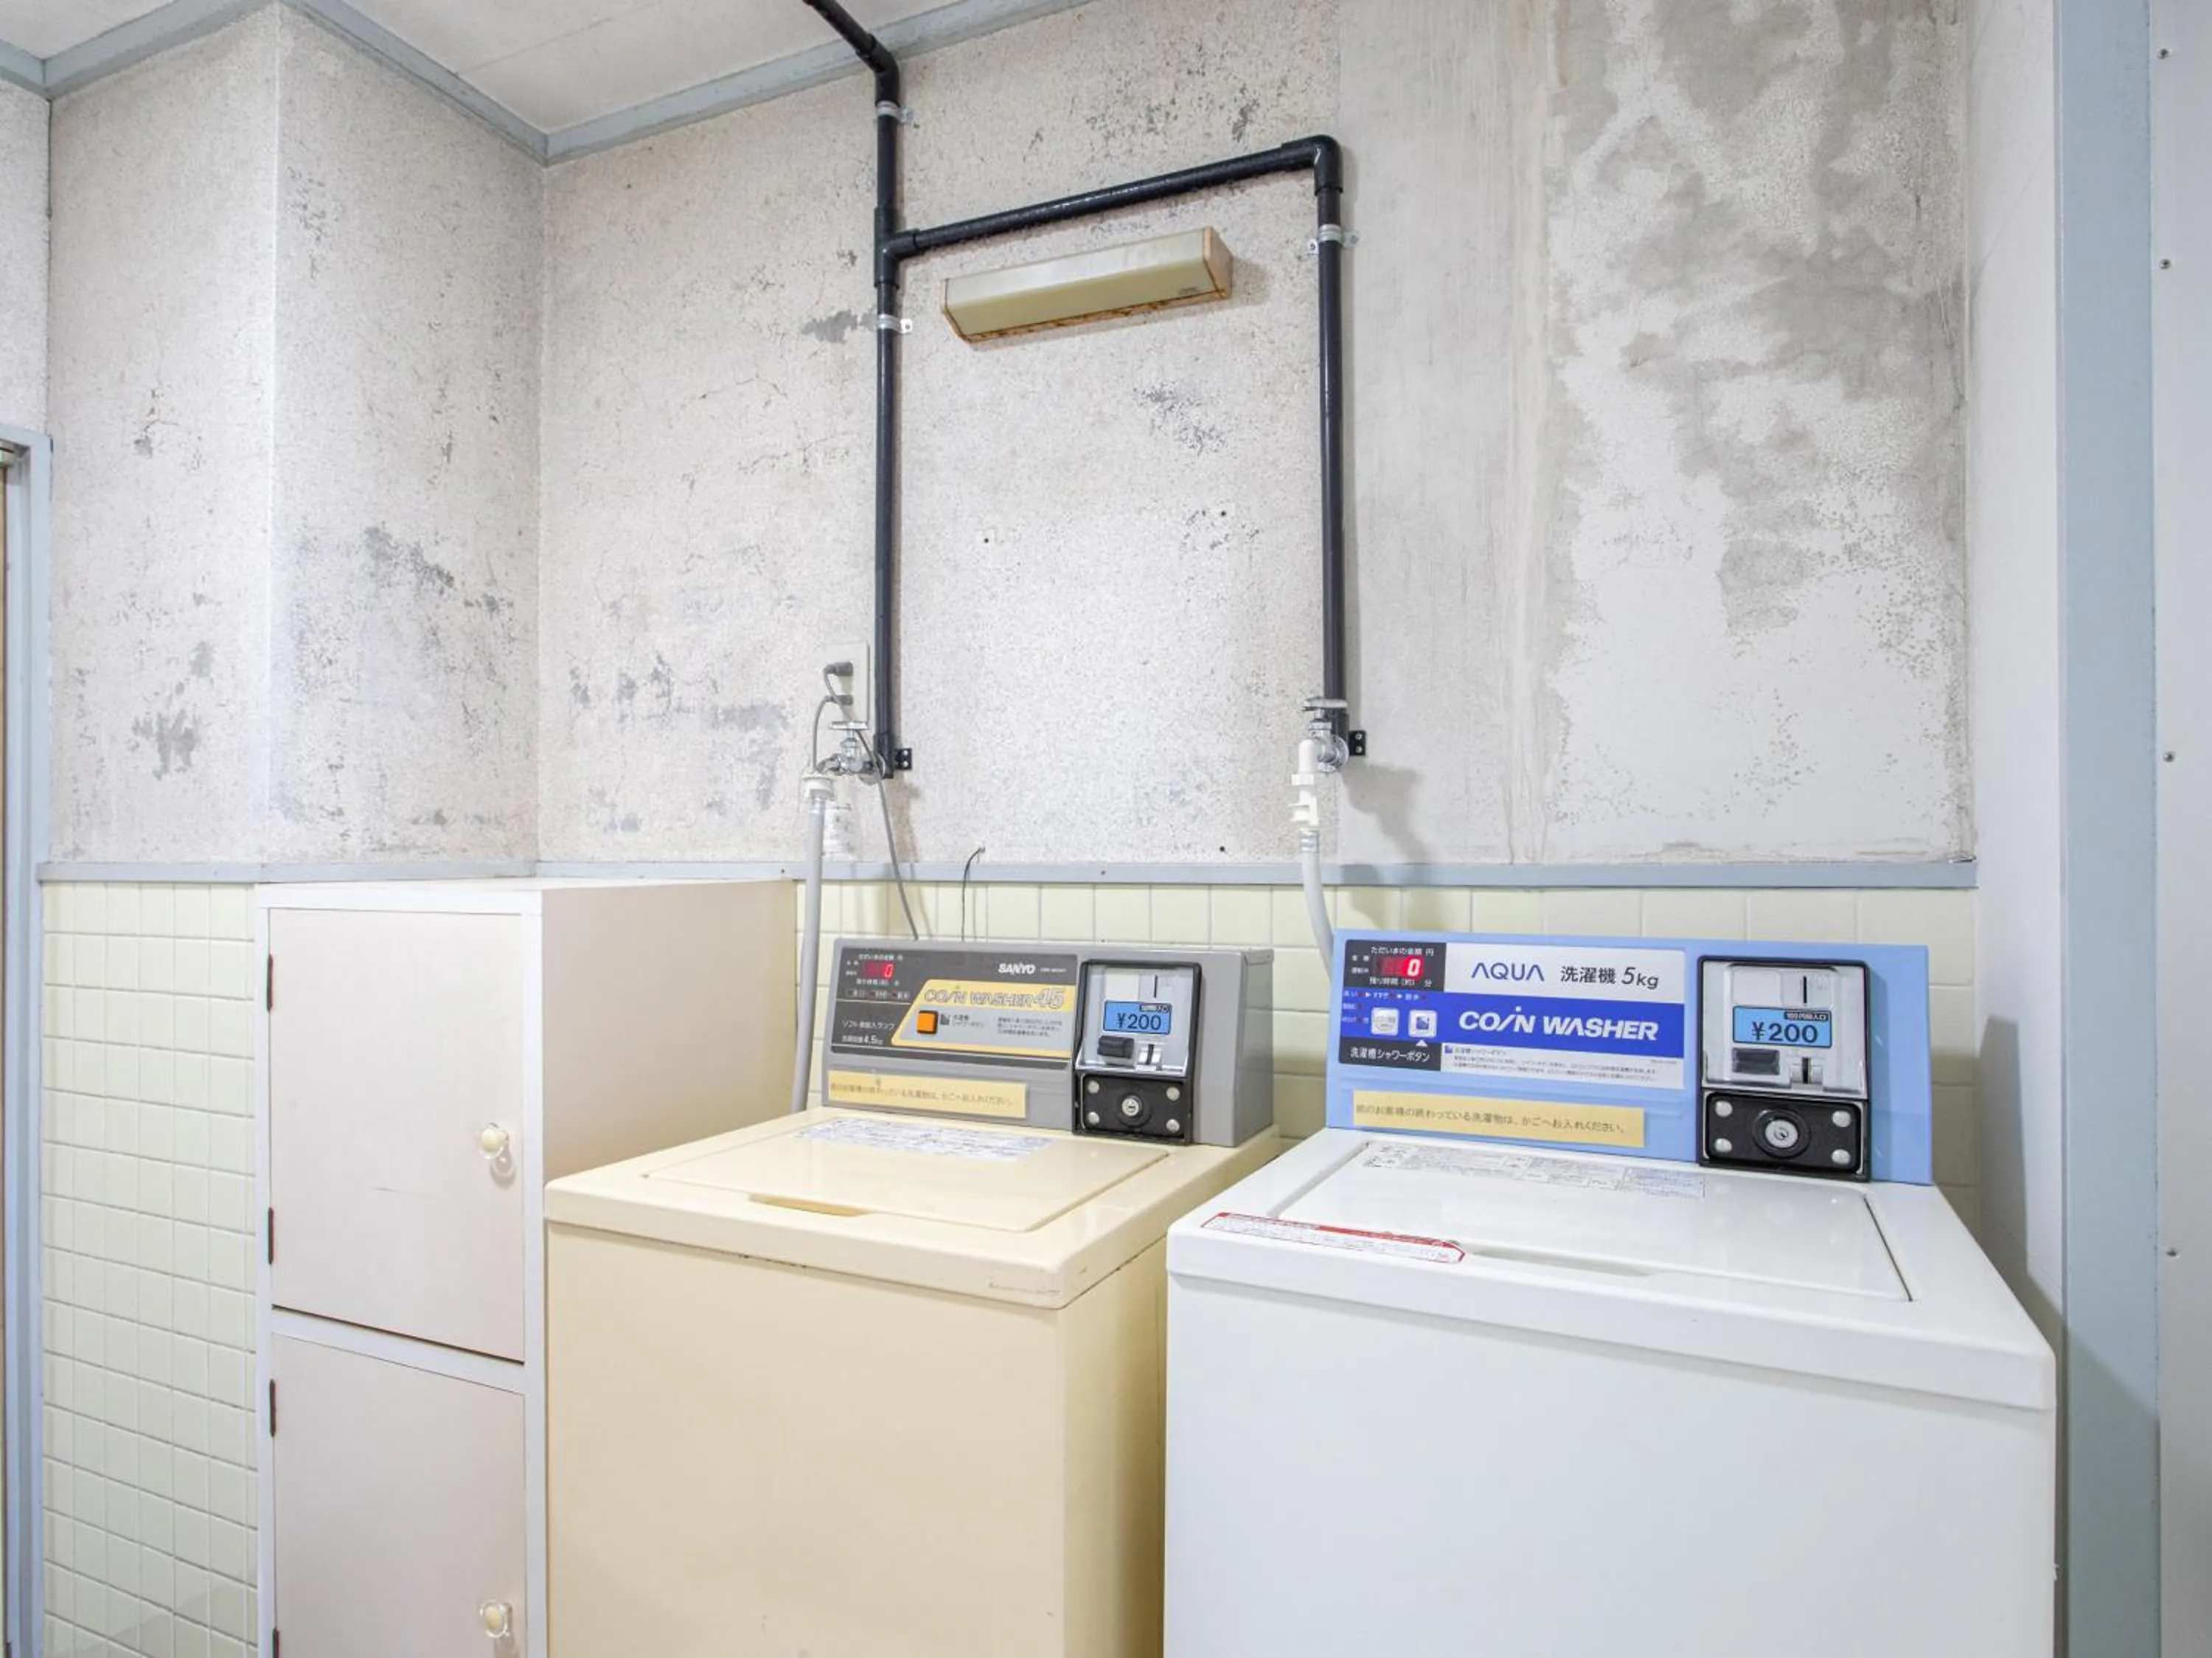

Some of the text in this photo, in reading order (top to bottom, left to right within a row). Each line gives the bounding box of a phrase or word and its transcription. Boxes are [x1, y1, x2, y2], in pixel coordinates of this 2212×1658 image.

[884, 963, 894, 977] 0
[998, 962, 1036, 975] SANYO
[1407, 958, 1421, 977] 0
[1471, 962, 1545, 982] AQUA
[1560, 965, 1616, 985] 洗濯機
[1116, 1012, 1161, 1030] ¥200
[1543, 1015, 1659, 1041] WASHER
[1751, 1021, 1818, 1044] ¥200
[1350, 1047, 1430, 1063] 洗濯槽シャワーボタン
